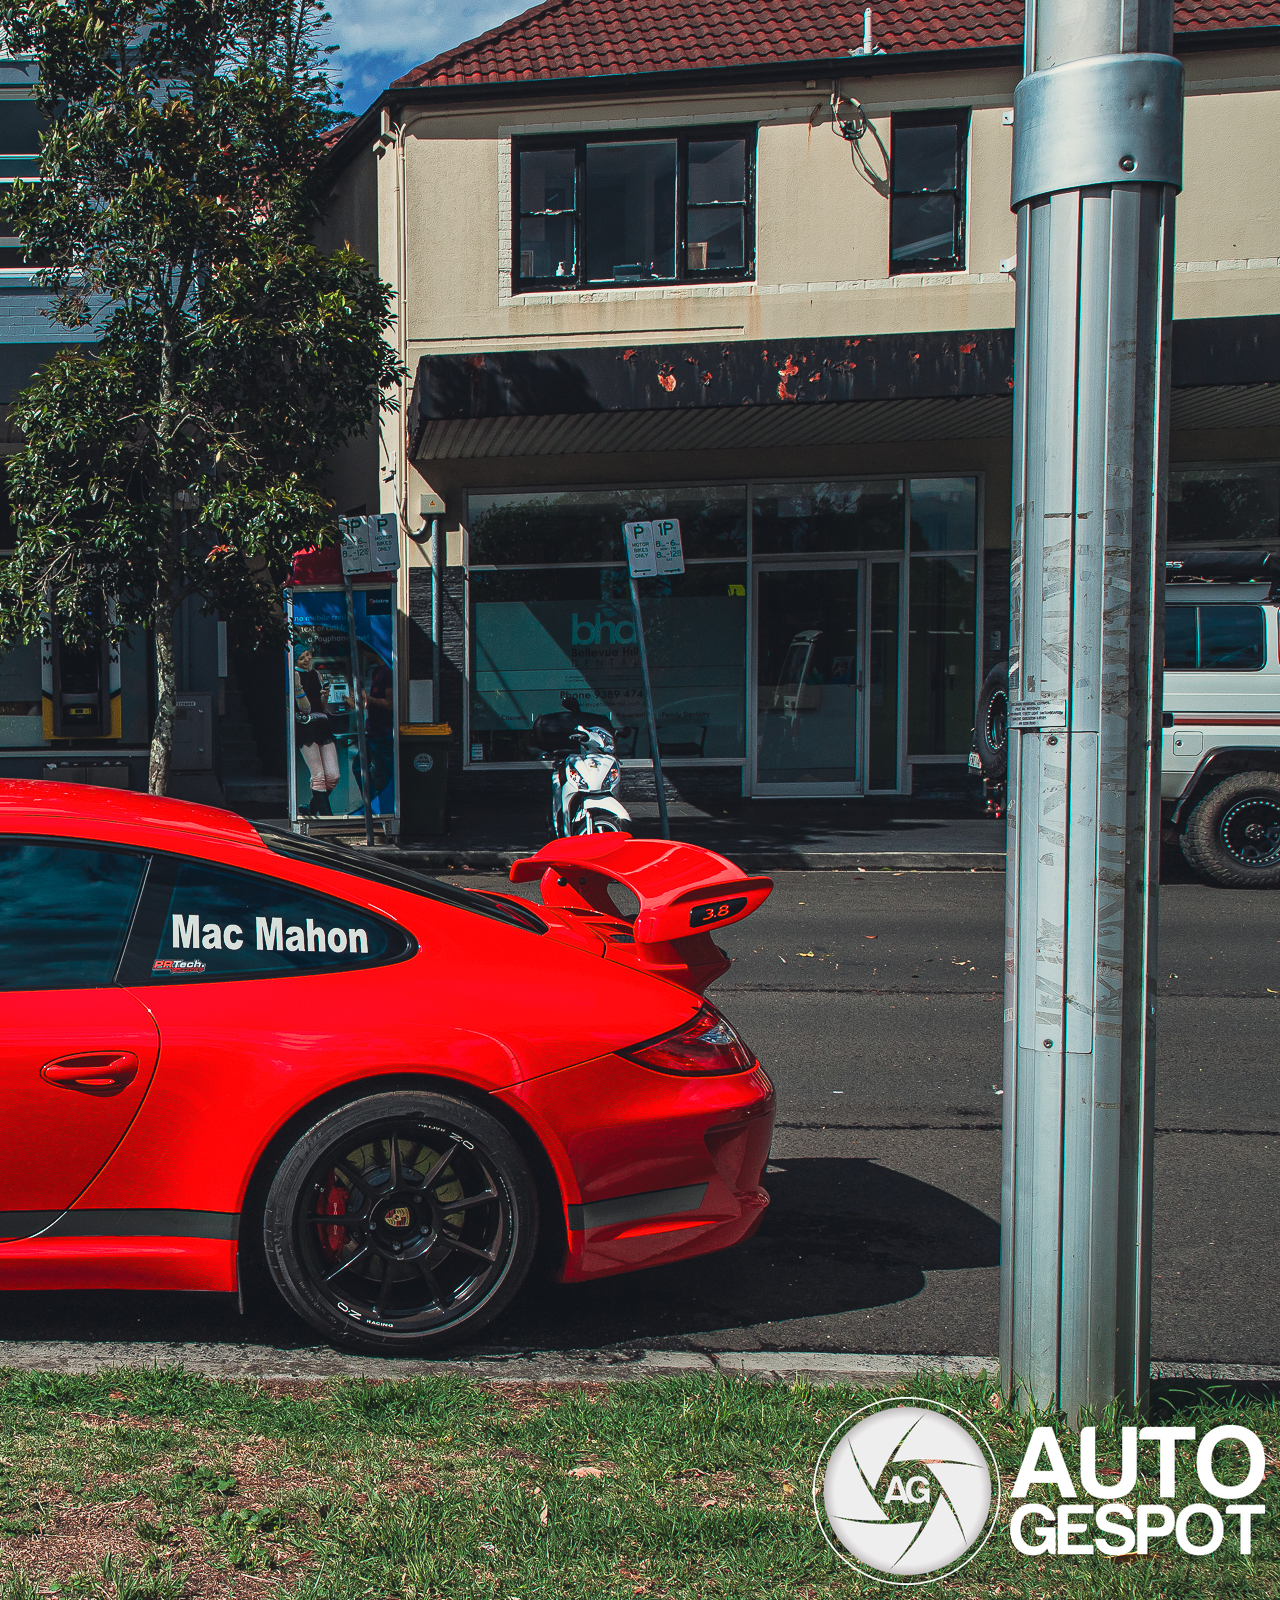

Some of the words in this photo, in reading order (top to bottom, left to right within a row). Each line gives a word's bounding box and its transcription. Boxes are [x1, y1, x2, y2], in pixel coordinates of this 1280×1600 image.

[377, 518, 388, 533] P
[633, 525, 644, 540] P
[658, 522, 674, 536] 1P
[571, 648, 619, 658] Bellevue
[623, 647, 639, 656] Hill
[572, 658, 640, 667] DENTAL
[560, 691, 590, 699] Phone
[594, 690, 621, 699] 9389
[624, 690, 644, 699] 474
[702, 904, 729, 921] 3.8
[172, 914, 244, 950] Mac
[255, 916, 369, 953] Mahon
[366, 1319, 394, 1328] RACING
